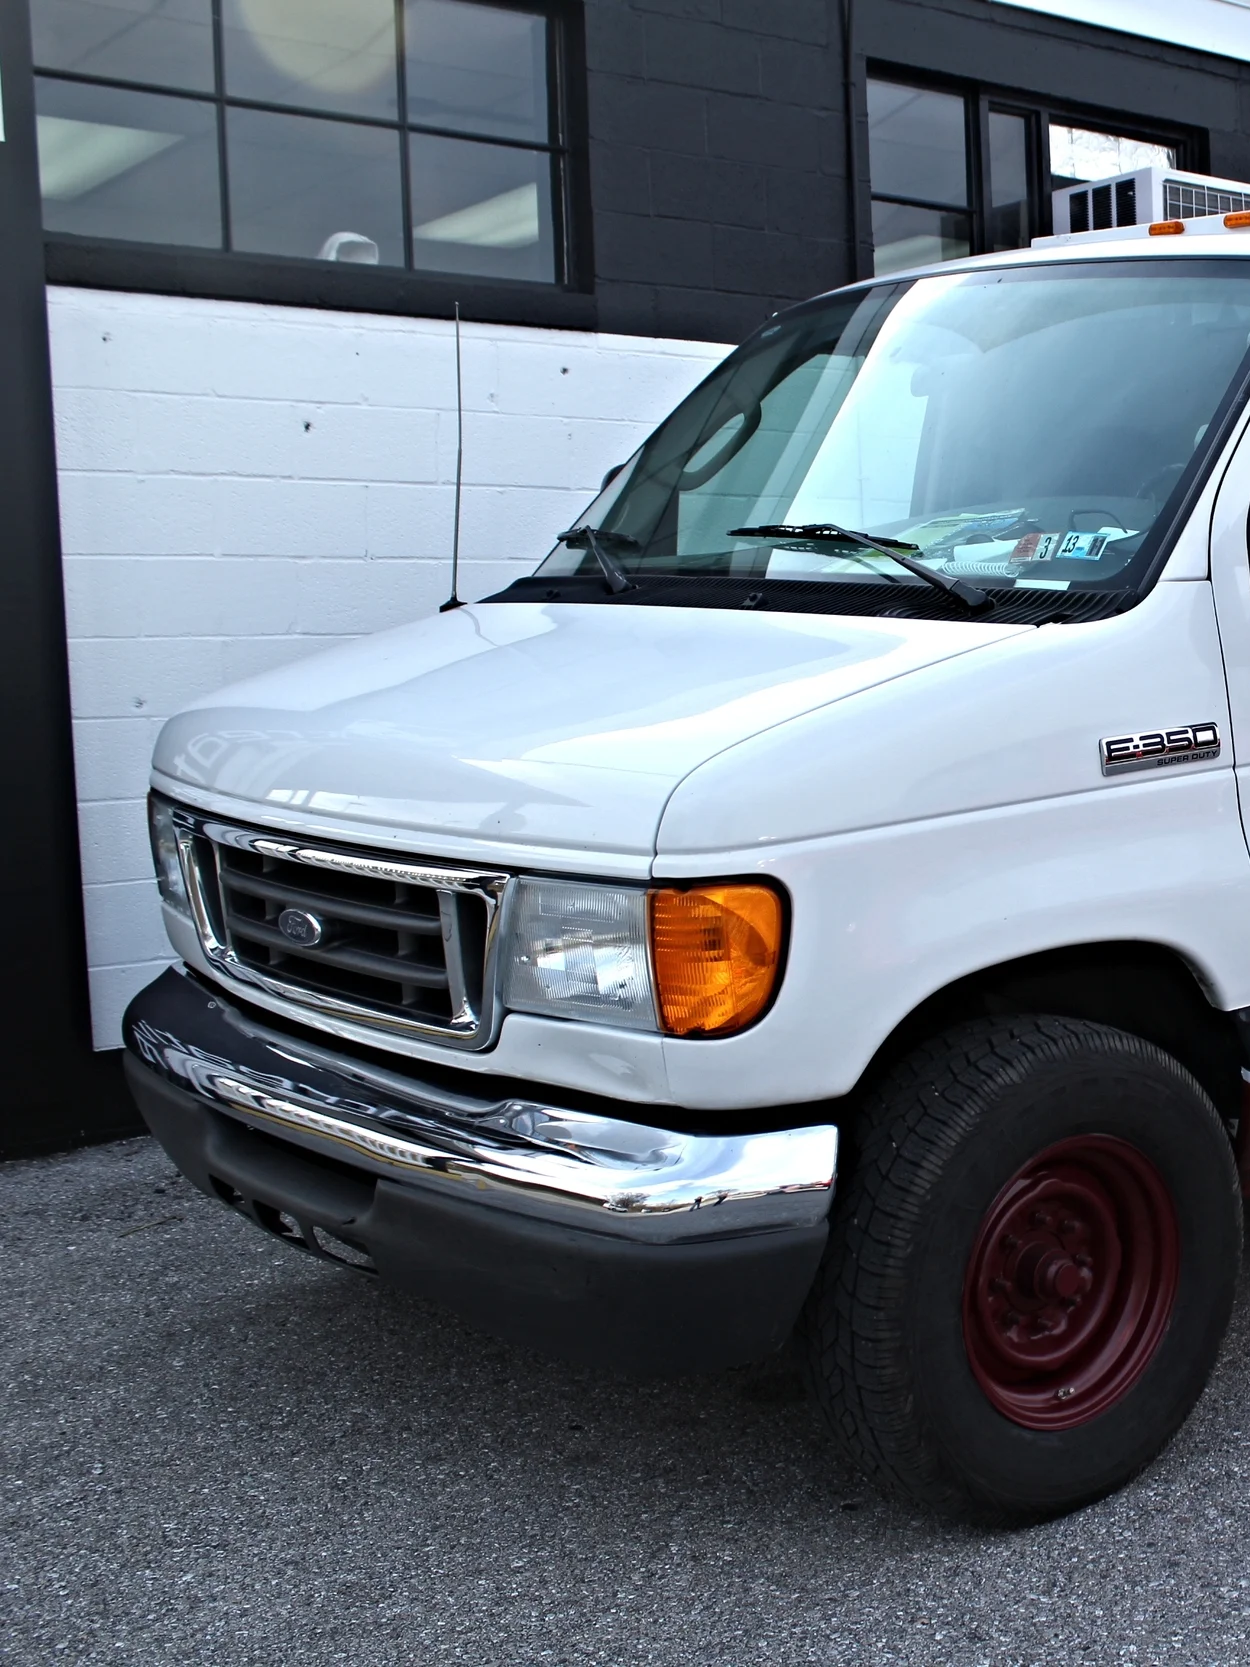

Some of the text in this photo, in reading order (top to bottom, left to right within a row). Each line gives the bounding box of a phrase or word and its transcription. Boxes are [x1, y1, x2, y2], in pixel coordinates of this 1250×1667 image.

[1039, 537, 1052, 559] 3
[1062, 535, 1080, 553] 13
[1157, 750, 1218, 766] SUPER DUTY
[286, 915, 307, 937] Ford
